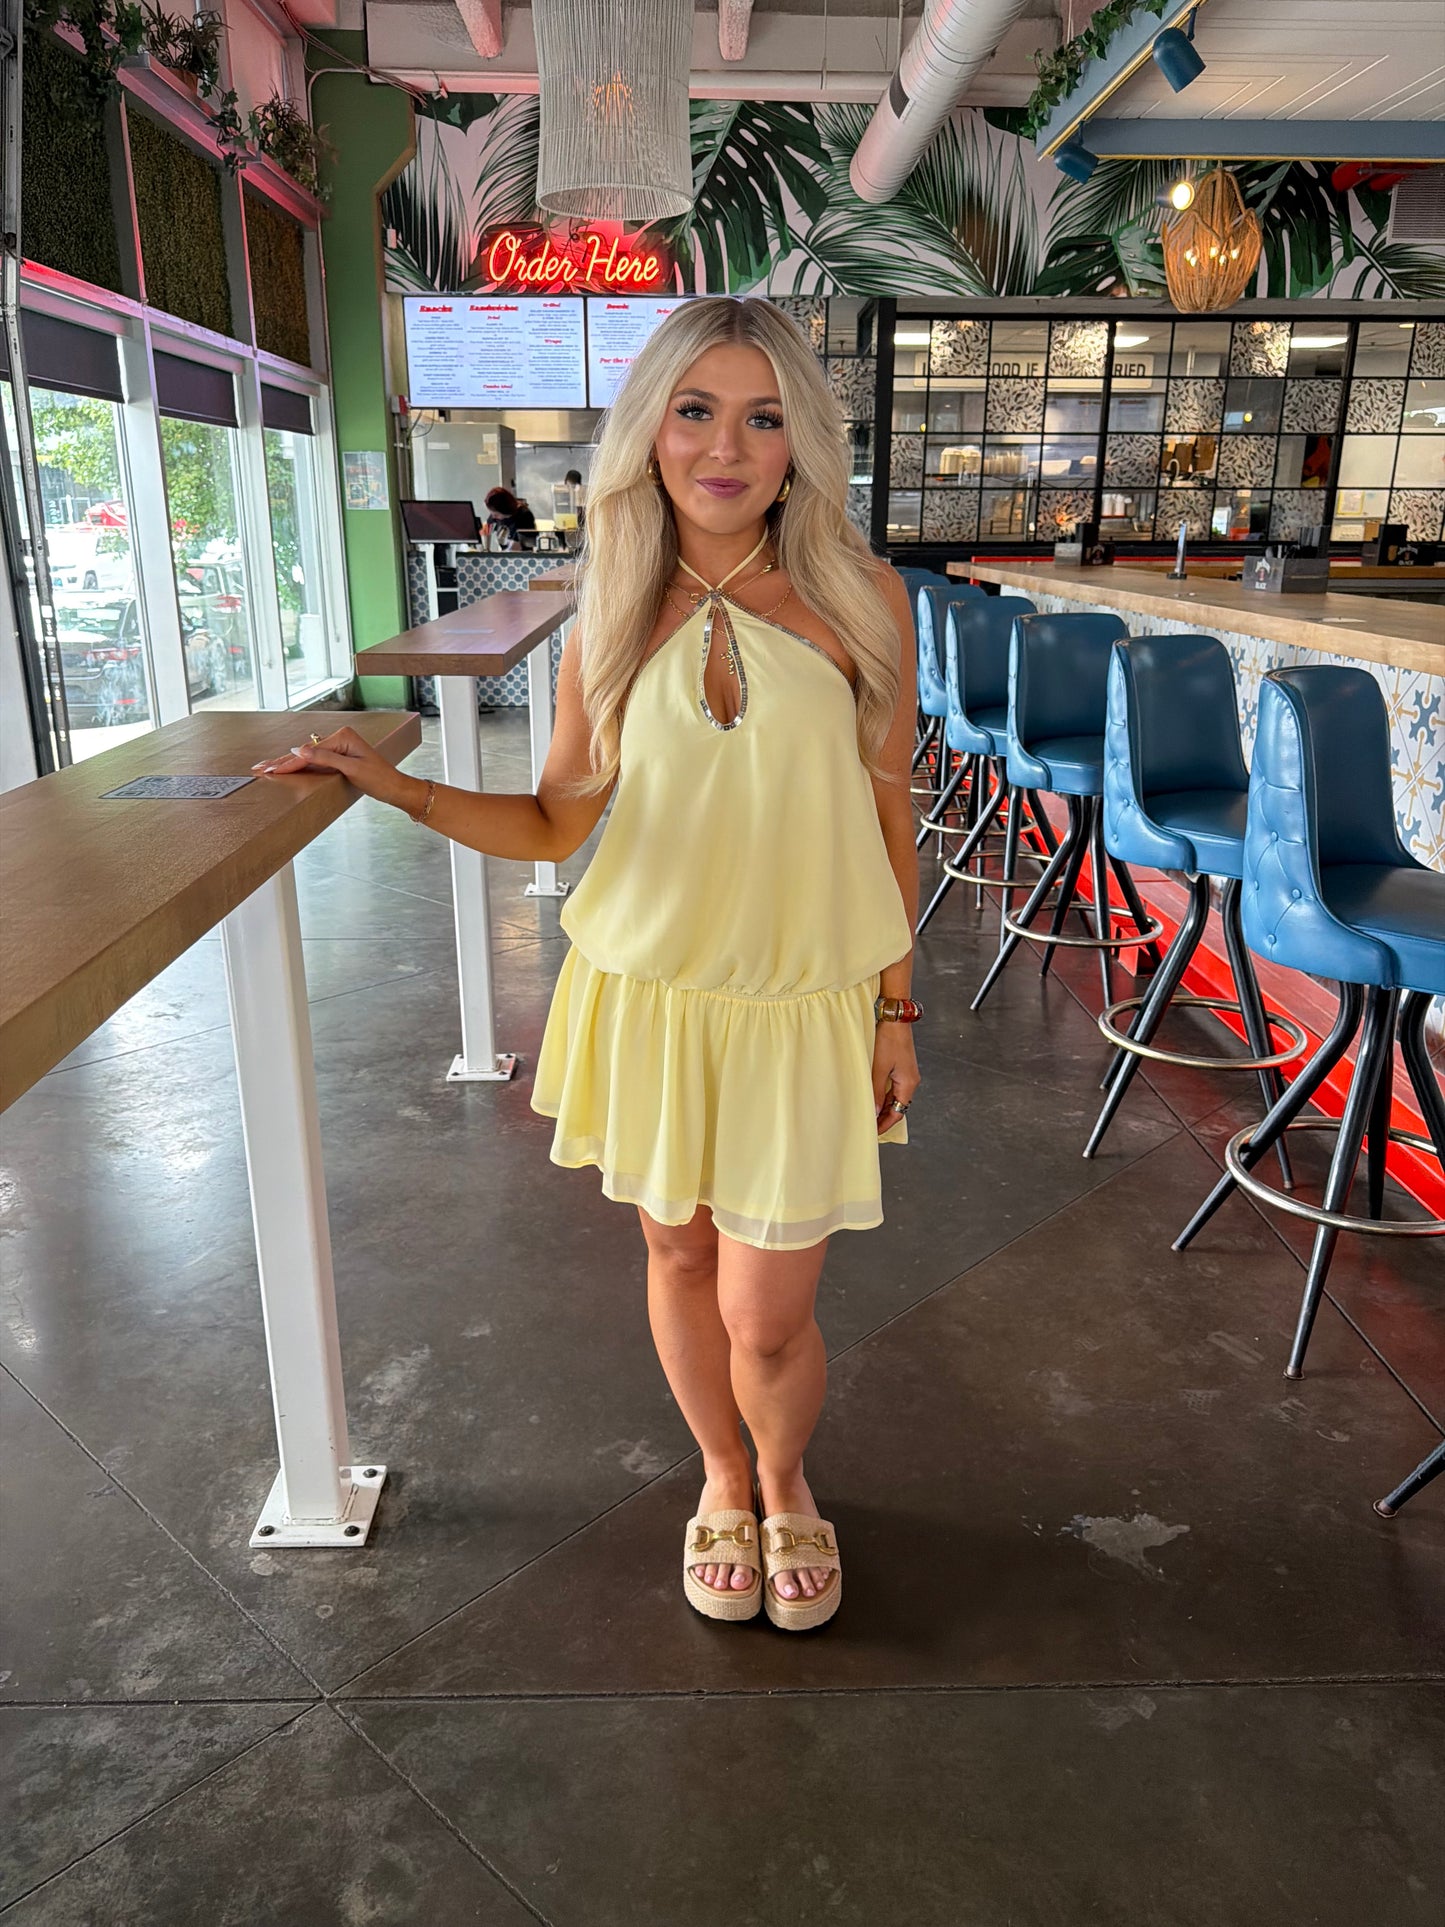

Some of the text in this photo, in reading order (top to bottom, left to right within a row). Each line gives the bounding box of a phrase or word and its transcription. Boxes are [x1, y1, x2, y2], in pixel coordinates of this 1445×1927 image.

[490, 231, 660, 282] Order Here
[419, 305, 453, 313] Snacks
[469, 304, 519, 312] Sandwiches
[992, 362, 1021, 377] OOD
[1114, 363, 1146, 377] RIED
